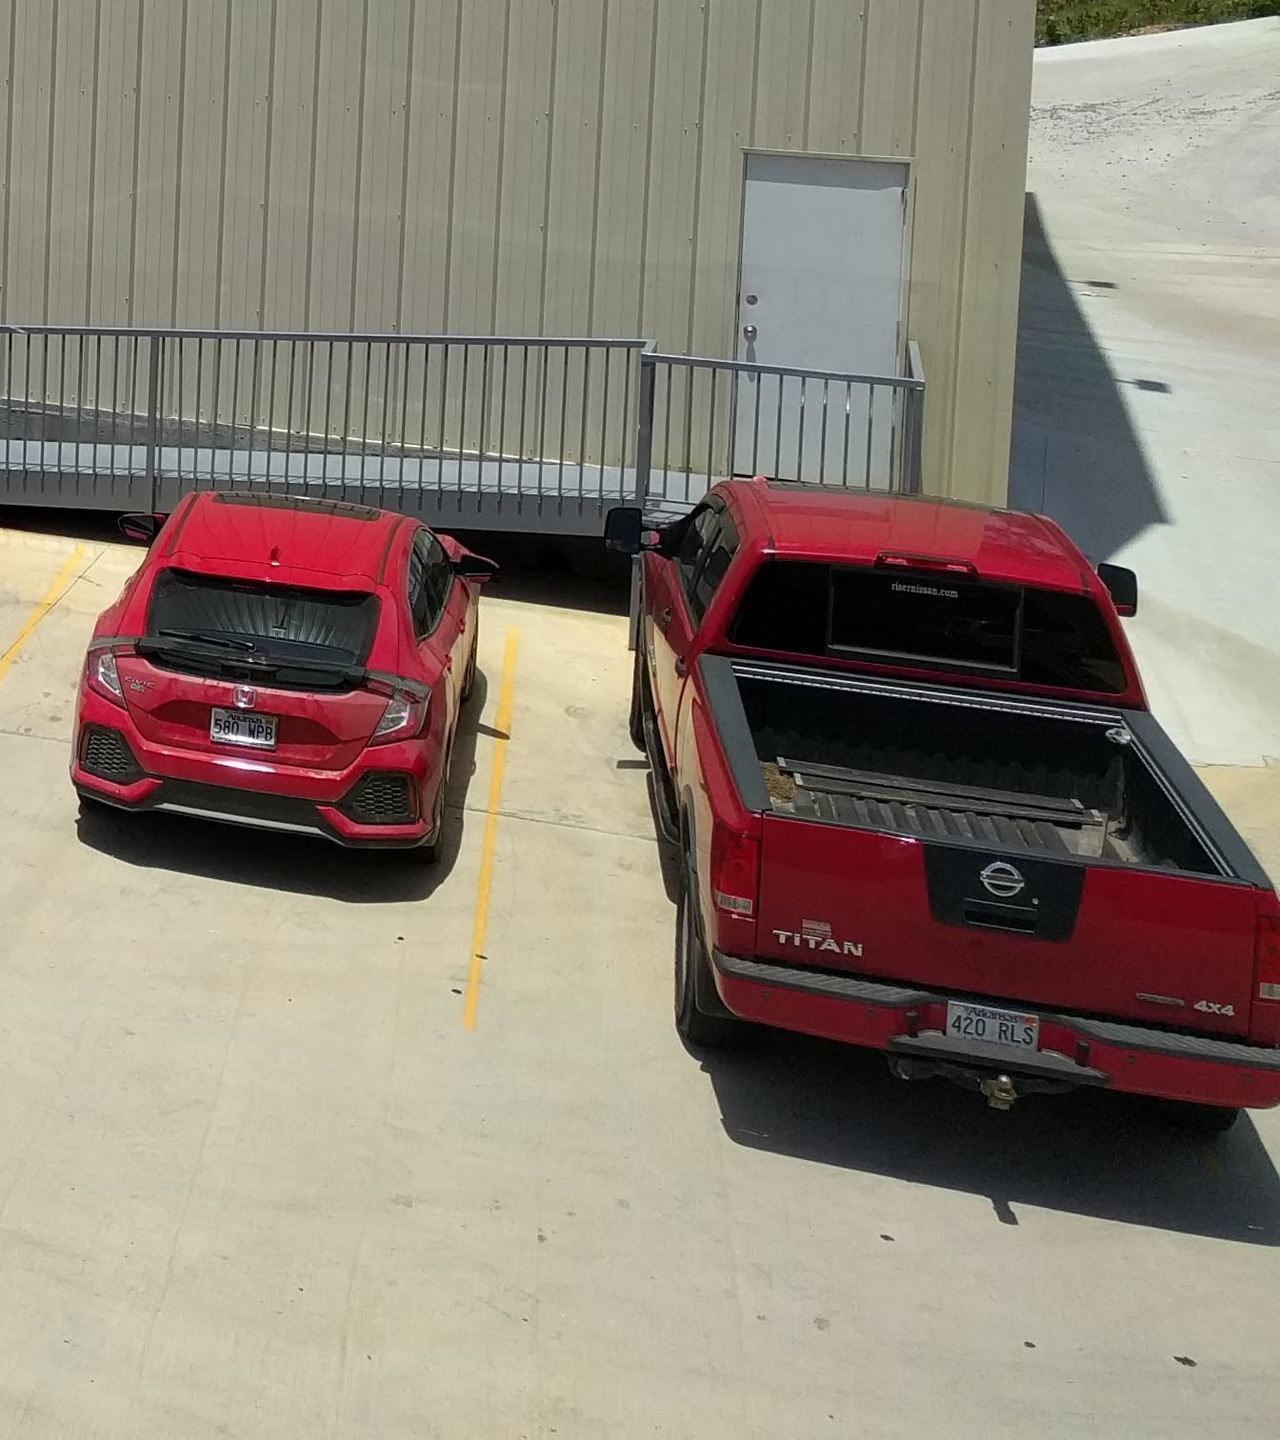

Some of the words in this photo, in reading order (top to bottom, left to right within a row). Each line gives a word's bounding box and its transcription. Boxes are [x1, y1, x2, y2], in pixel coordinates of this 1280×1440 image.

[214, 718, 239, 735] 580
[248, 721, 273, 742] WPB
[772, 929, 863, 957] TITAN
[951, 1015, 987, 1037] 420
[998, 1022, 1034, 1046] RLS
